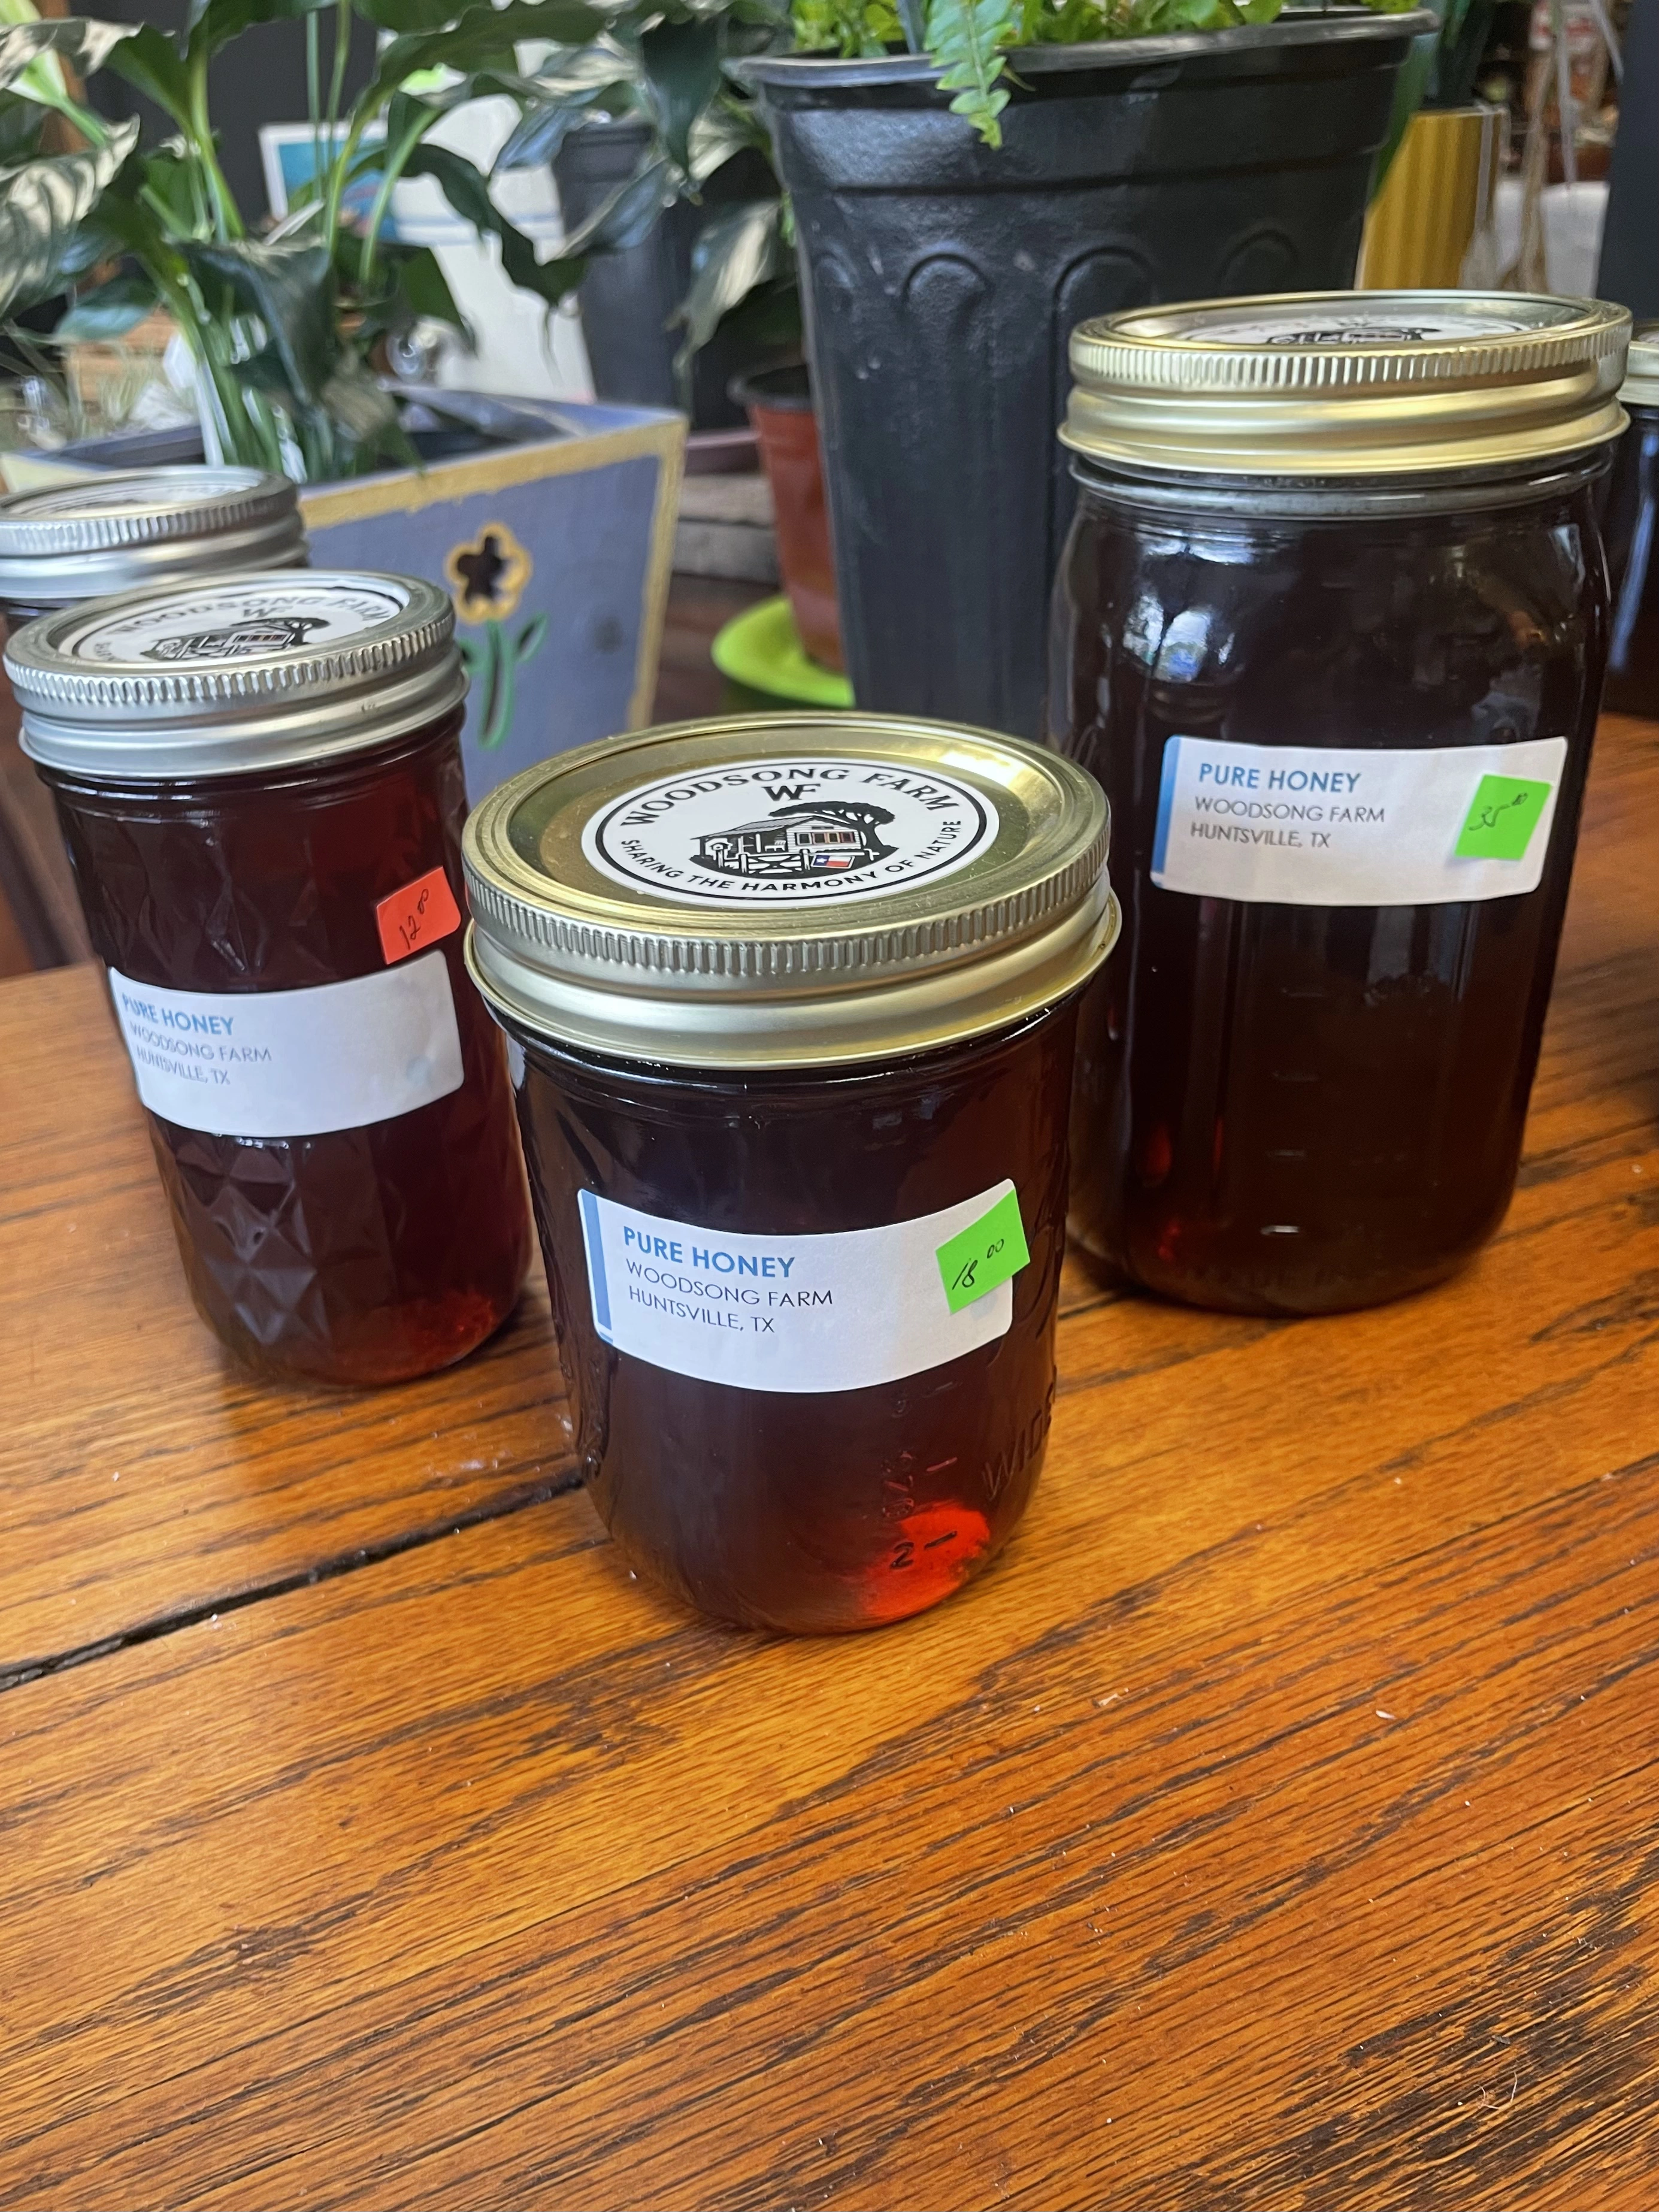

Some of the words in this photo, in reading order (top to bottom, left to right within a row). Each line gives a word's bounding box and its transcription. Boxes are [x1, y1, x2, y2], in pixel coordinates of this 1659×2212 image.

[621, 768, 850, 828] WOODSONG
[866, 772, 960, 812] FARM
[762, 783, 821, 801] WF
[1199, 763, 1261, 789] PURE
[1268, 770, 1361, 794] HONEY
[1194, 796, 1324, 822] WOODSONG
[1330, 806, 1385, 822] FARM
[620, 839, 682, 879] SHARING
[692, 874, 734, 891] THE
[741, 870, 878, 892] HARMONY
[884, 858, 914, 874] OF
[920, 819, 962, 860] NATURE
[1311, 833, 1331, 848] TX
[122, 992, 158, 1024] PURE
[162, 1007, 234, 1036] HONEY
[129, 1020, 215, 1061] WOODSONG
[219, 1046, 272, 1062] FARM
[210, 1067, 231, 1085] TX
[623, 1225, 683, 1263] PURE
[692, 1246, 795, 1278] HONEY
[625, 1259, 761, 1306] WOODSONG
[768, 1290, 833, 1308] FARM
[629, 1285, 744, 1333] HUNTSVILLE,
[750, 1317, 776, 1333] TX
